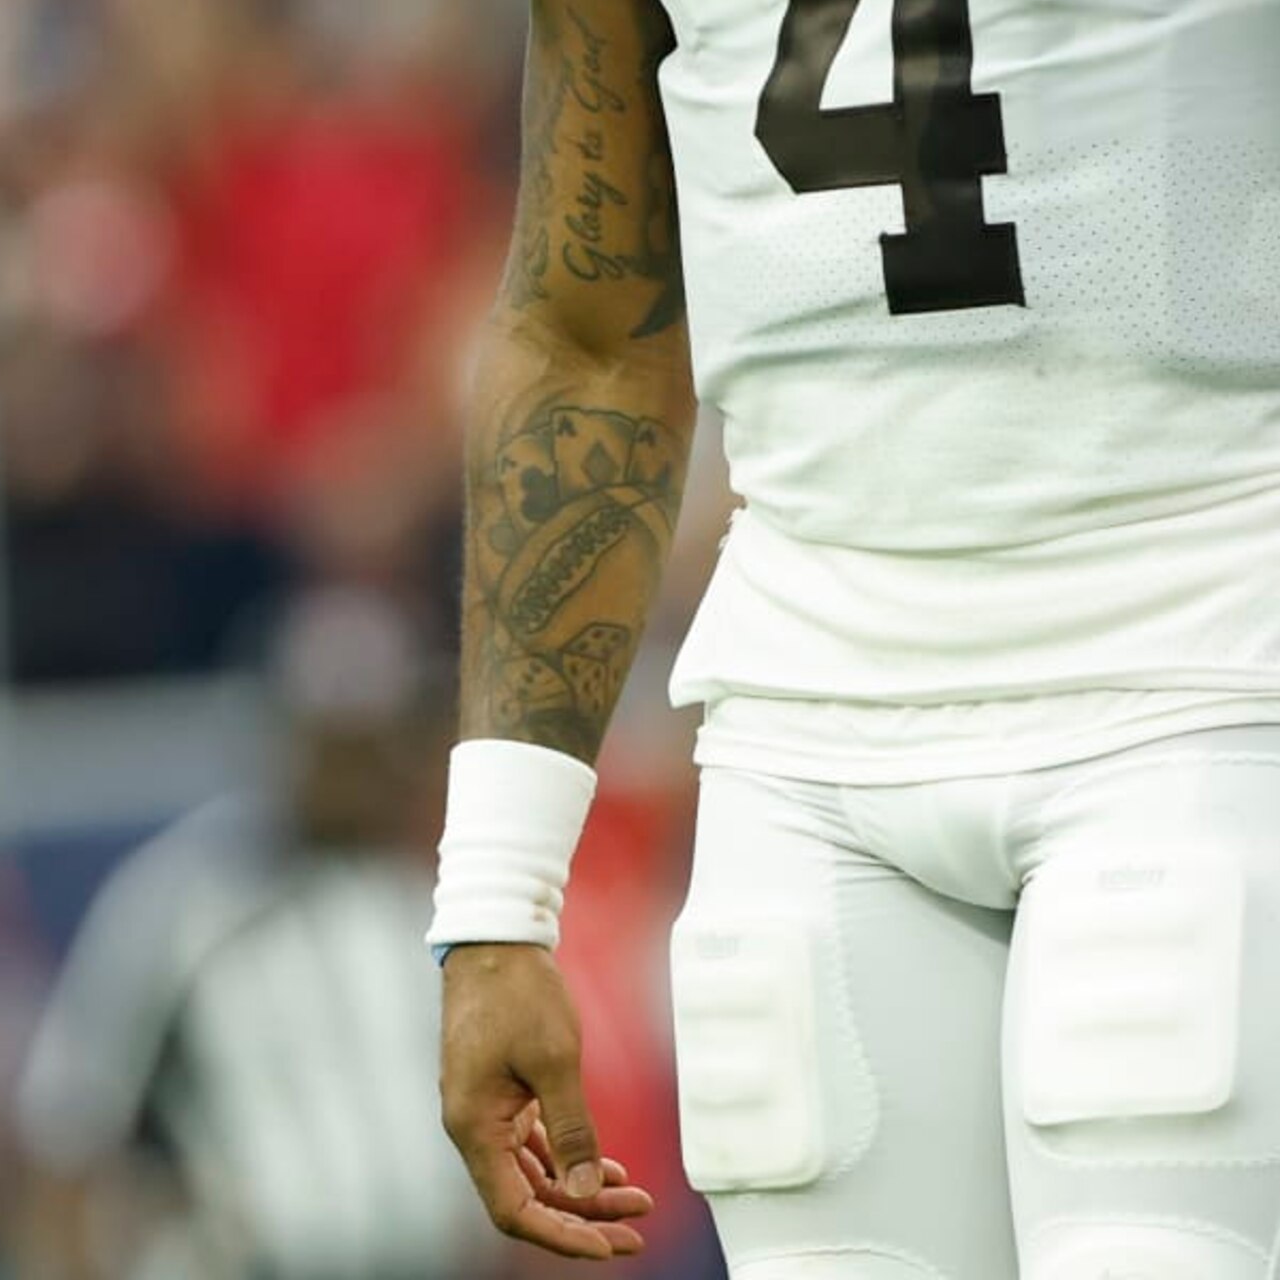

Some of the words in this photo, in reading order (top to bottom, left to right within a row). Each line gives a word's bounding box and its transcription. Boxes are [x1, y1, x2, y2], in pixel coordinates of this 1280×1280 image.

[567, 5, 627, 114] God
[568, 129, 604, 161] to
[562, 171, 629, 282] Glory
